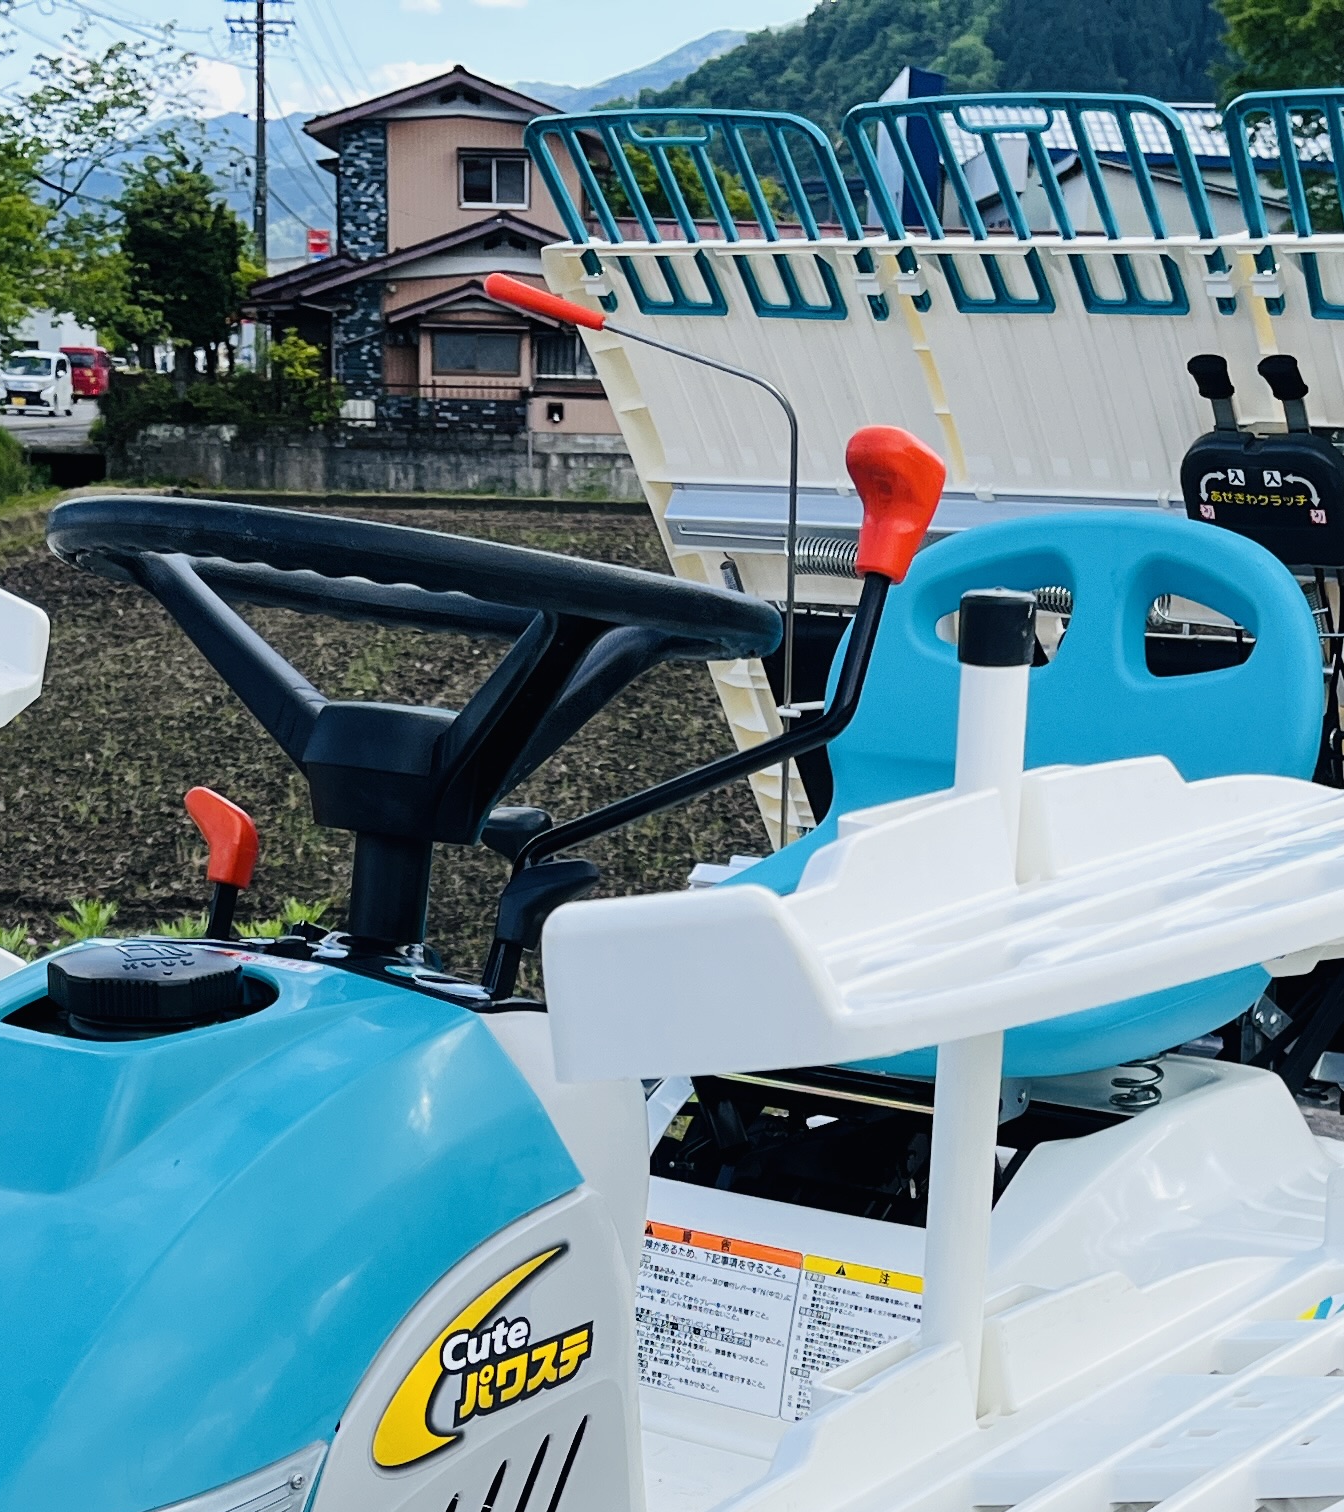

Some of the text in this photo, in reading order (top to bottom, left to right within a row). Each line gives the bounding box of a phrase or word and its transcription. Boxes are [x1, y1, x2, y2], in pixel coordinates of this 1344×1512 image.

[1230, 470, 1244, 484] 入
[1266, 472, 1281, 486] 入
[442, 1320, 529, 1371] Cute
[459, 1329, 588, 1419] パワステ
